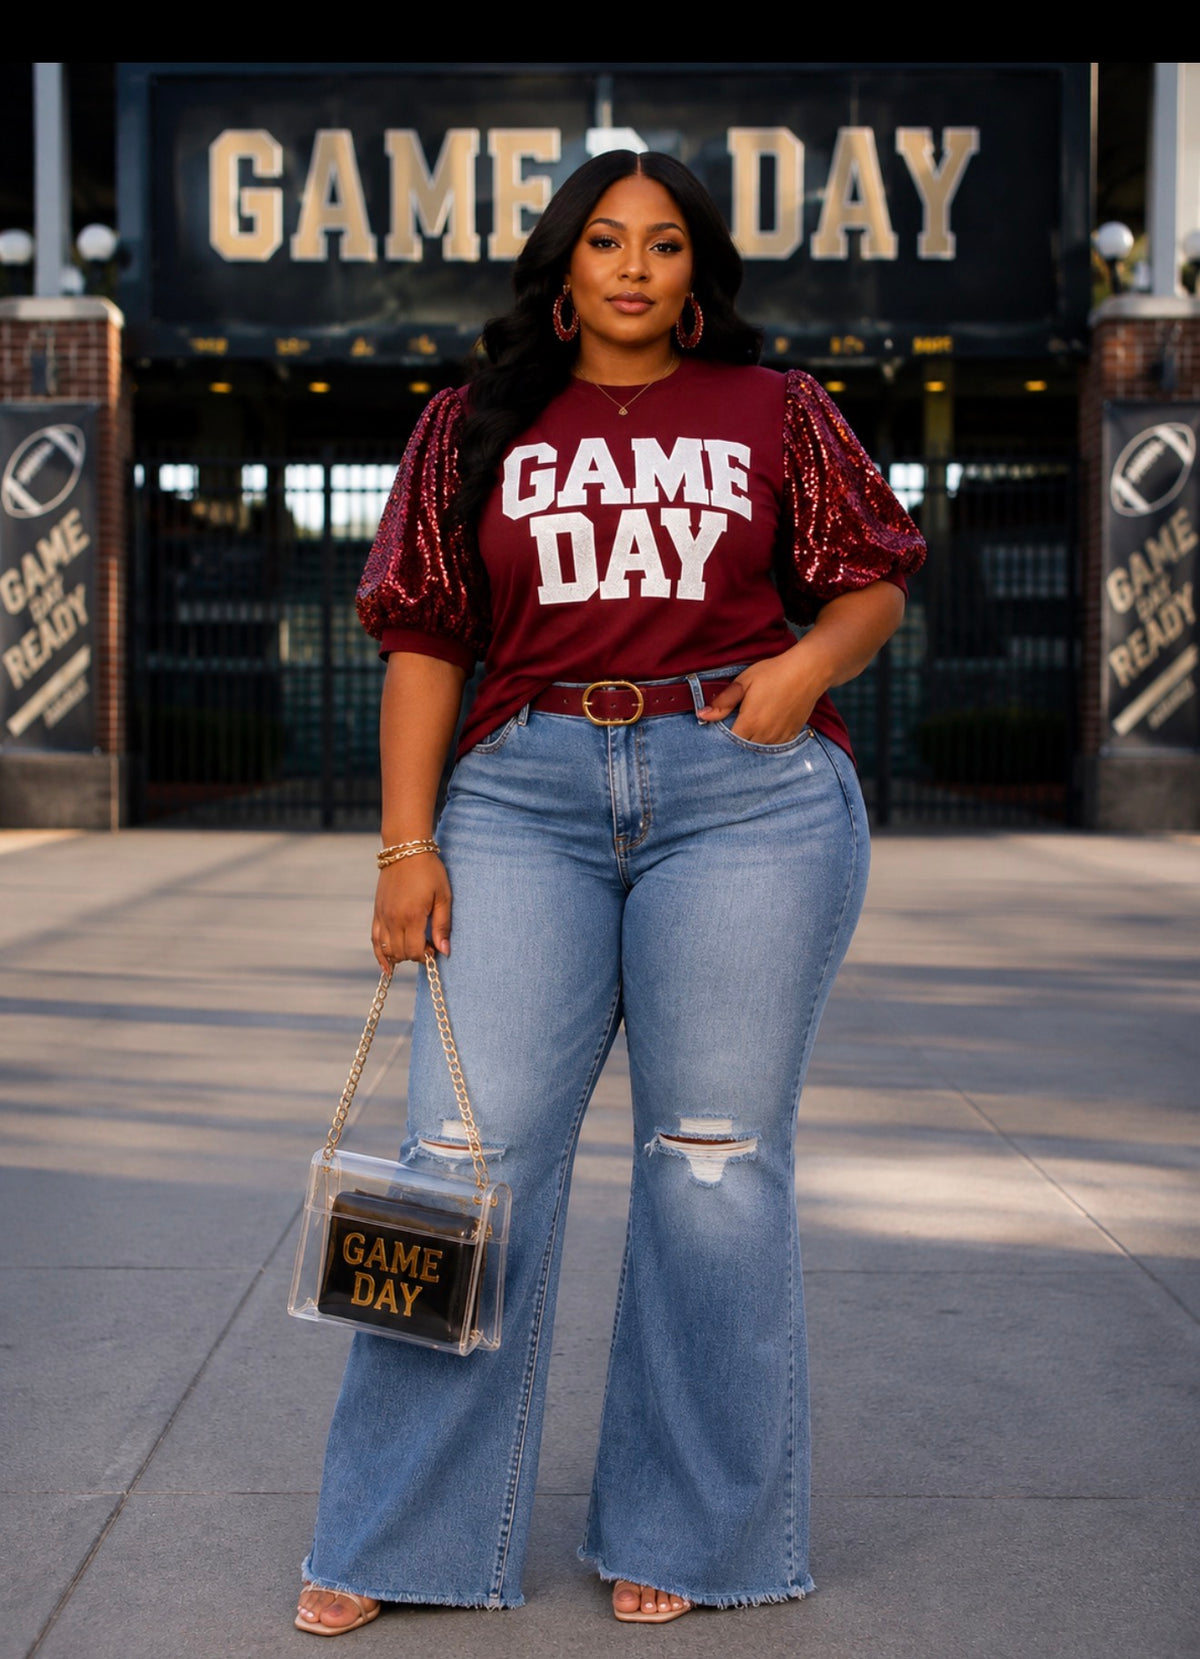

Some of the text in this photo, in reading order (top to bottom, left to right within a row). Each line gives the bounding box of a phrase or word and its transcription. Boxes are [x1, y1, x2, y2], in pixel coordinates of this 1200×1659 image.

[209, 126, 979, 262] GAME DAY
[502, 437, 752, 522] GAME
[0, 507, 90, 615] GAME
[529, 507, 728, 605] DAY
[1106, 507, 1198, 614] GAME
[3, 583, 88, 690] READY
[1109, 581, 1196, 688] READY
[343, 1232, 443, 1283] GAME
[351, 1271, 422, 1317] DAY
